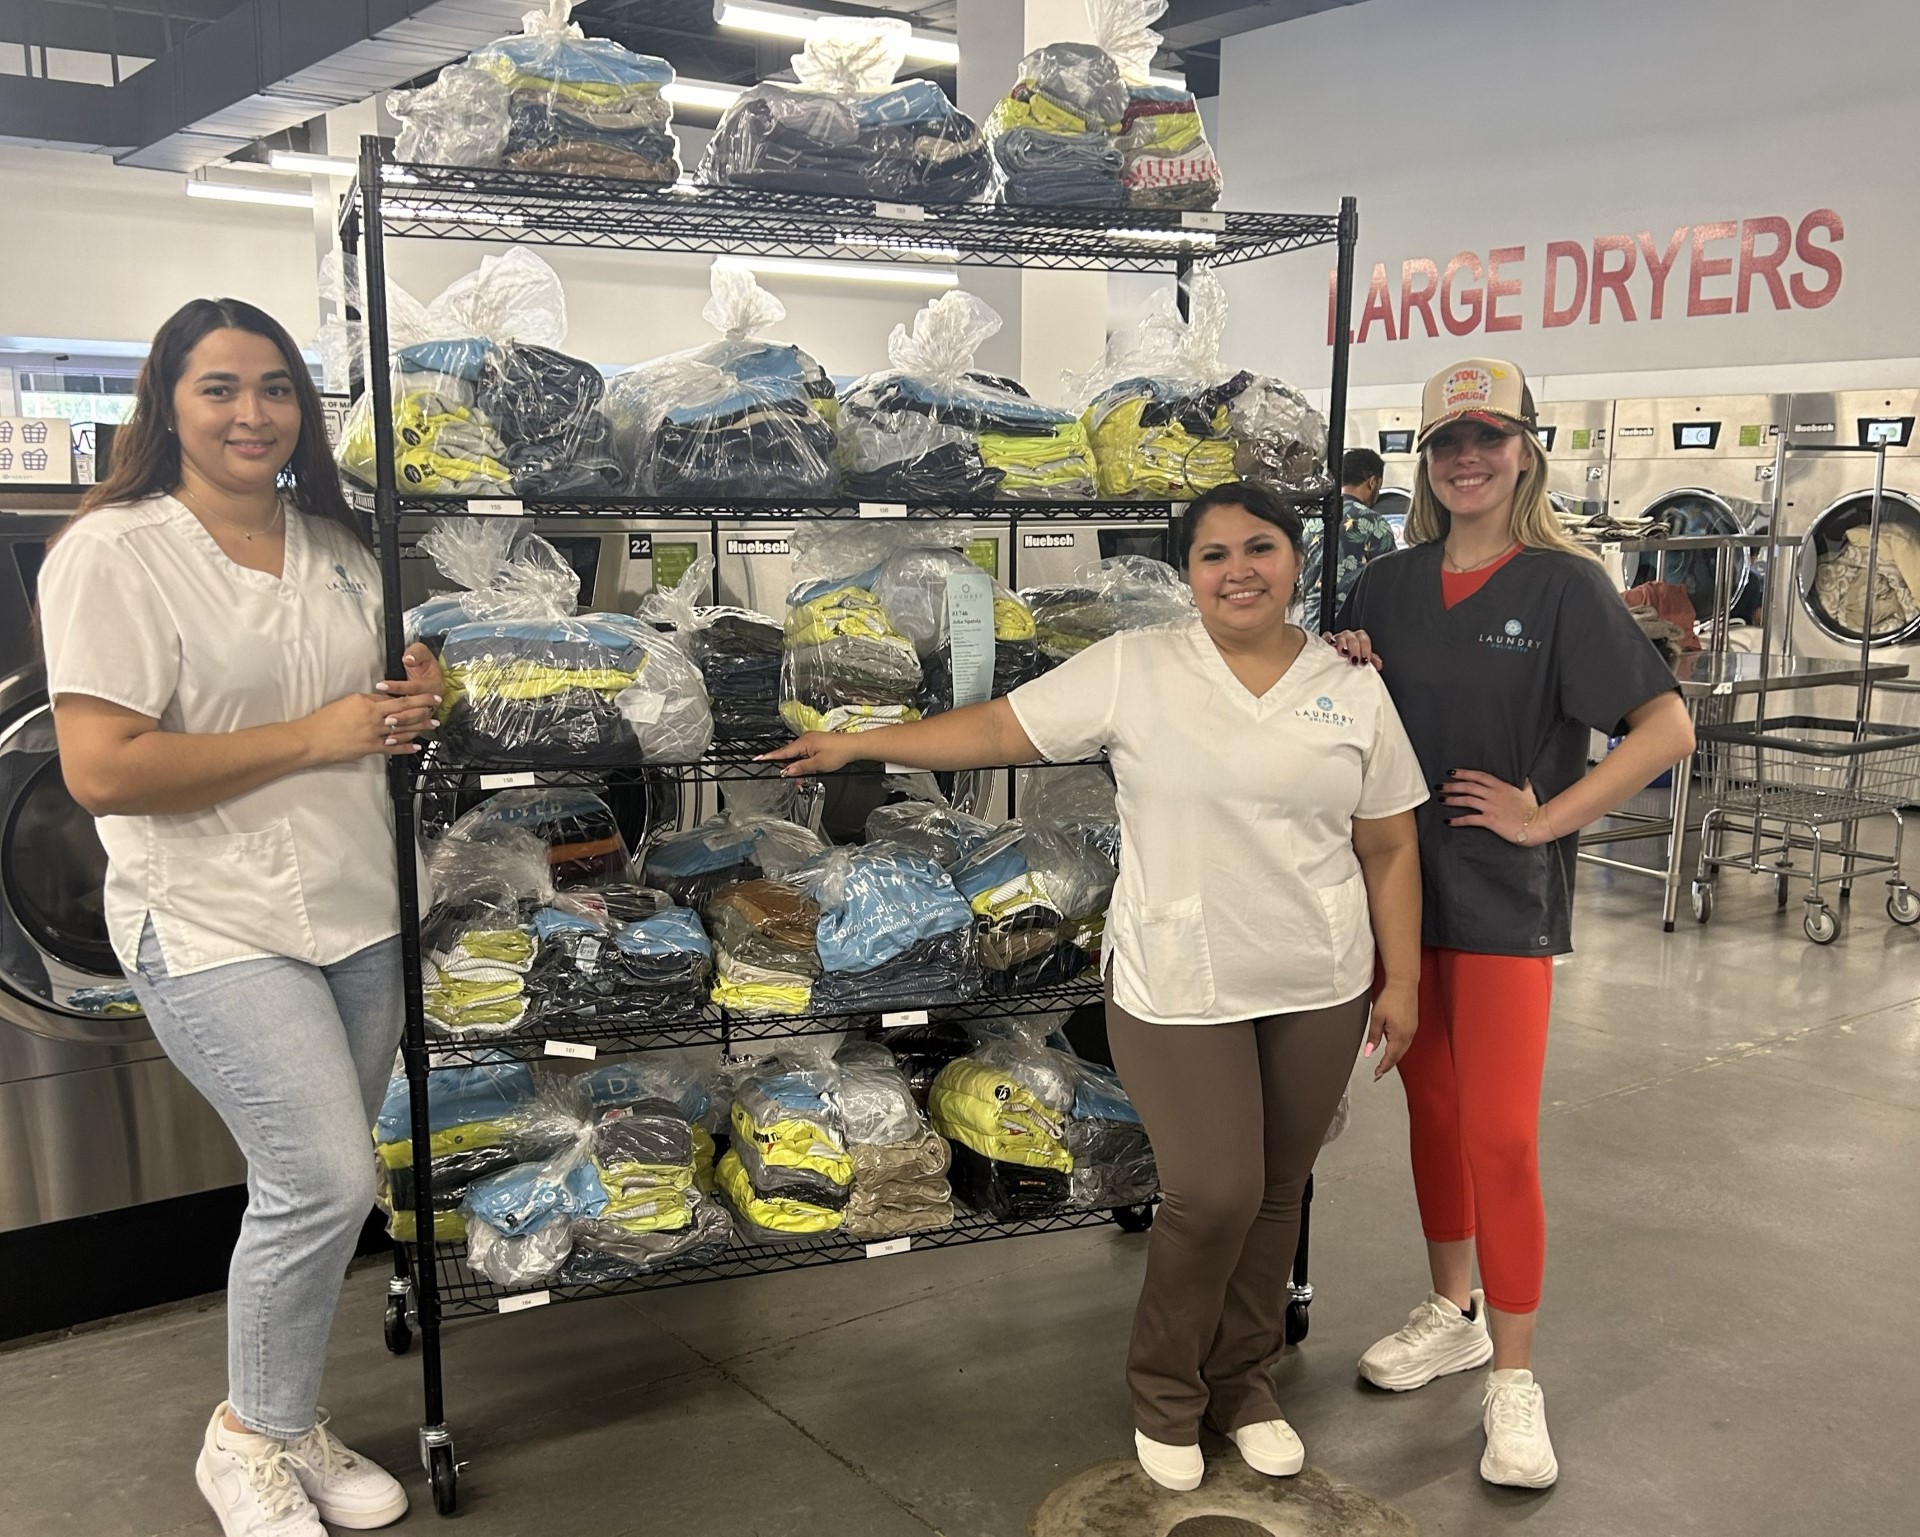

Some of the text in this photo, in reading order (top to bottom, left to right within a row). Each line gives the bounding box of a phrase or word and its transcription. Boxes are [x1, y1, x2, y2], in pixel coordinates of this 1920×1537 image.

[1327, 208, 1844, 346] LARGE DRYERS
[1455, 370, 1478, 382] YOU
[1447, 391, 1486, 406] ENOUGH
[1795, 423, 1835, 432] Huebsch
[631, 540, 650, 553] 22
[728, 541, 789, 554] Huebsch
[1023, 535, 1074, 547] Huebsch
[1479, 634, 1542, 649] LAUNDRY
[1295, 710, 1354, 725] LAUNDRY
